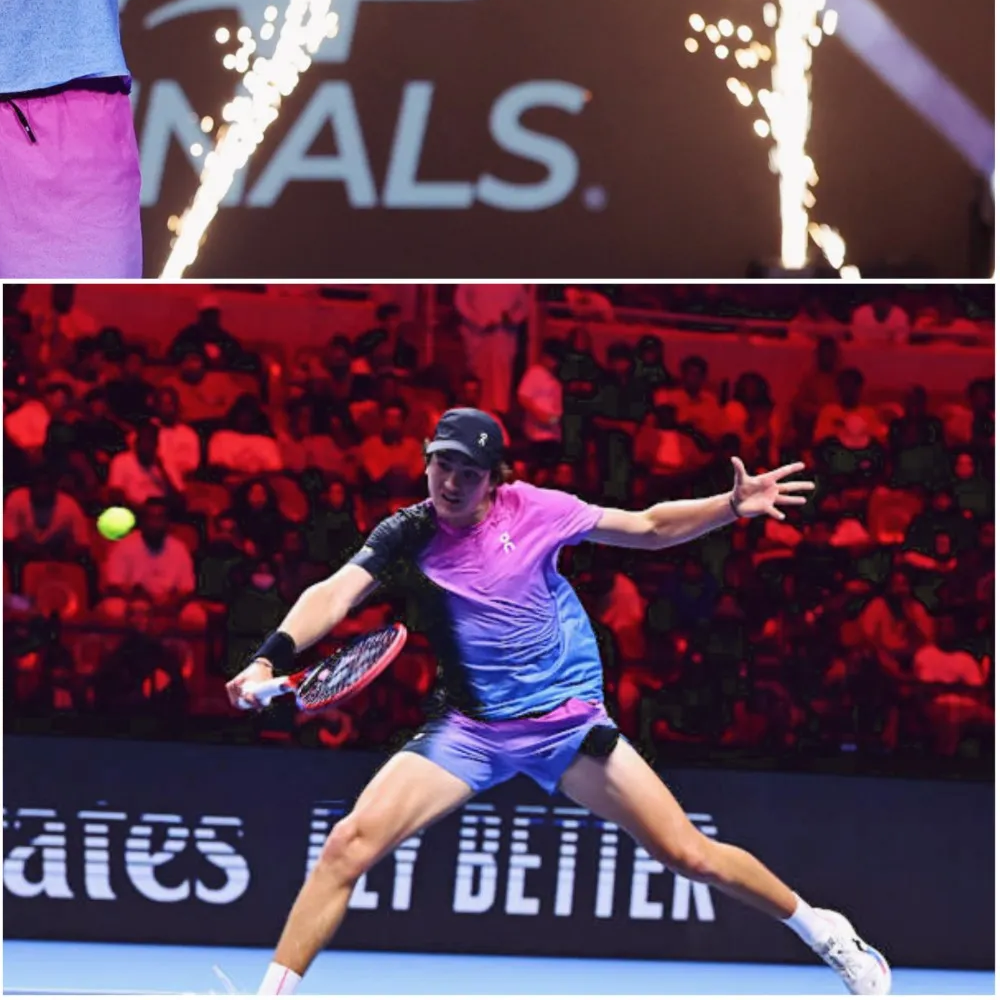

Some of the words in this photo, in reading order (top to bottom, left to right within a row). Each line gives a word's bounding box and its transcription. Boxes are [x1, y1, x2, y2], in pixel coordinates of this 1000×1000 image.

[131, 79, 588, 211] NALS
[3, 806, 250, 904] ates
[453, 804, 718, 922] BETTER
